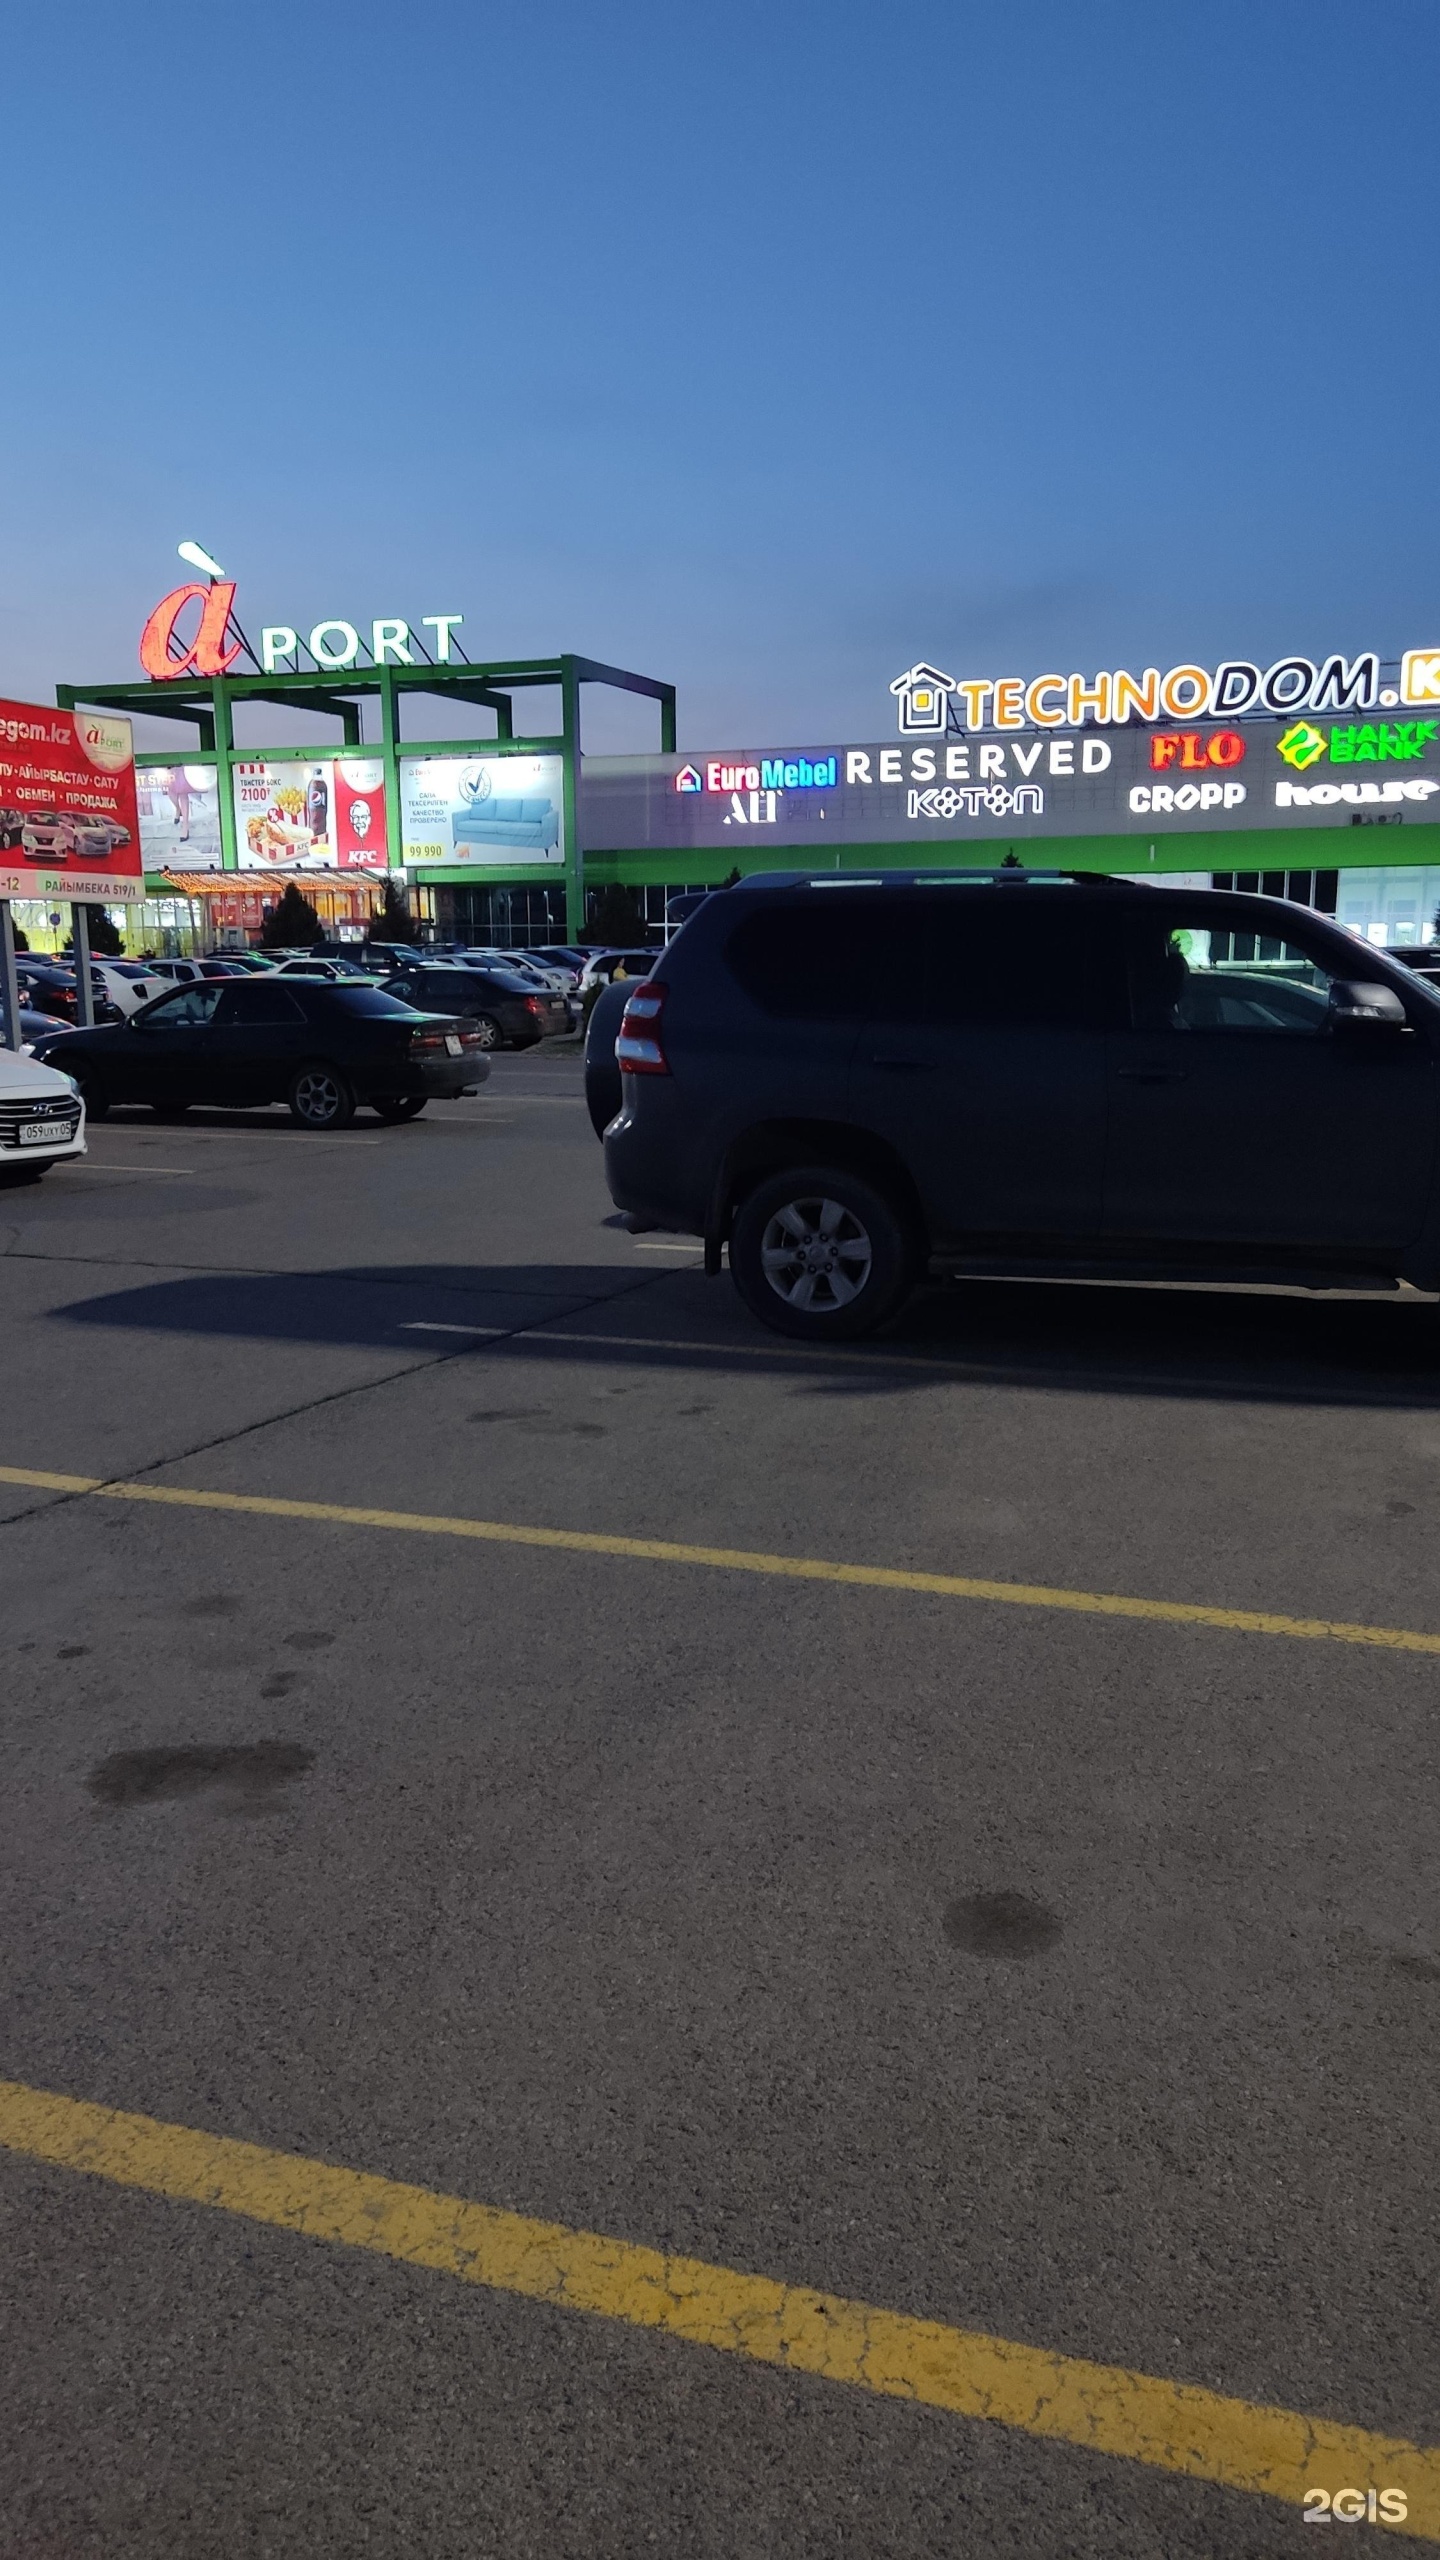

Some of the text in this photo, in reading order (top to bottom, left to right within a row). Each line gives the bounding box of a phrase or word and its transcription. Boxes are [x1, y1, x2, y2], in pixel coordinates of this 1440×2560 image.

[1329, 719, 1439, 745] HALYK
[846, 739, 1112, 784] RESERVED
[1150, 731, 1246, 771] FLO
[1329, 741, 1426, 763] BANK
[19, 764, 90, 786] АЙЫРБАСТАУ
[94, 776, 119, 790] САТУ
[240, 778, 282, 787] ТВИСТЕР БОКС
[16, 786, 56, 803] ОБМЕН
[66, 792, 118, 810] ПРОДАЖА
[1129, 782, 1247, 813] CROPP
[1275, 779, 1440, 807] house
[297, 841, 309, 851] KFC
[348, 850, 377, 863] KFC
[409, 845, 442, 857] 99 990
[45, 878, 110, 894] РАЙЫМБЕКА
[113, 884, 136, 898] 519/1
